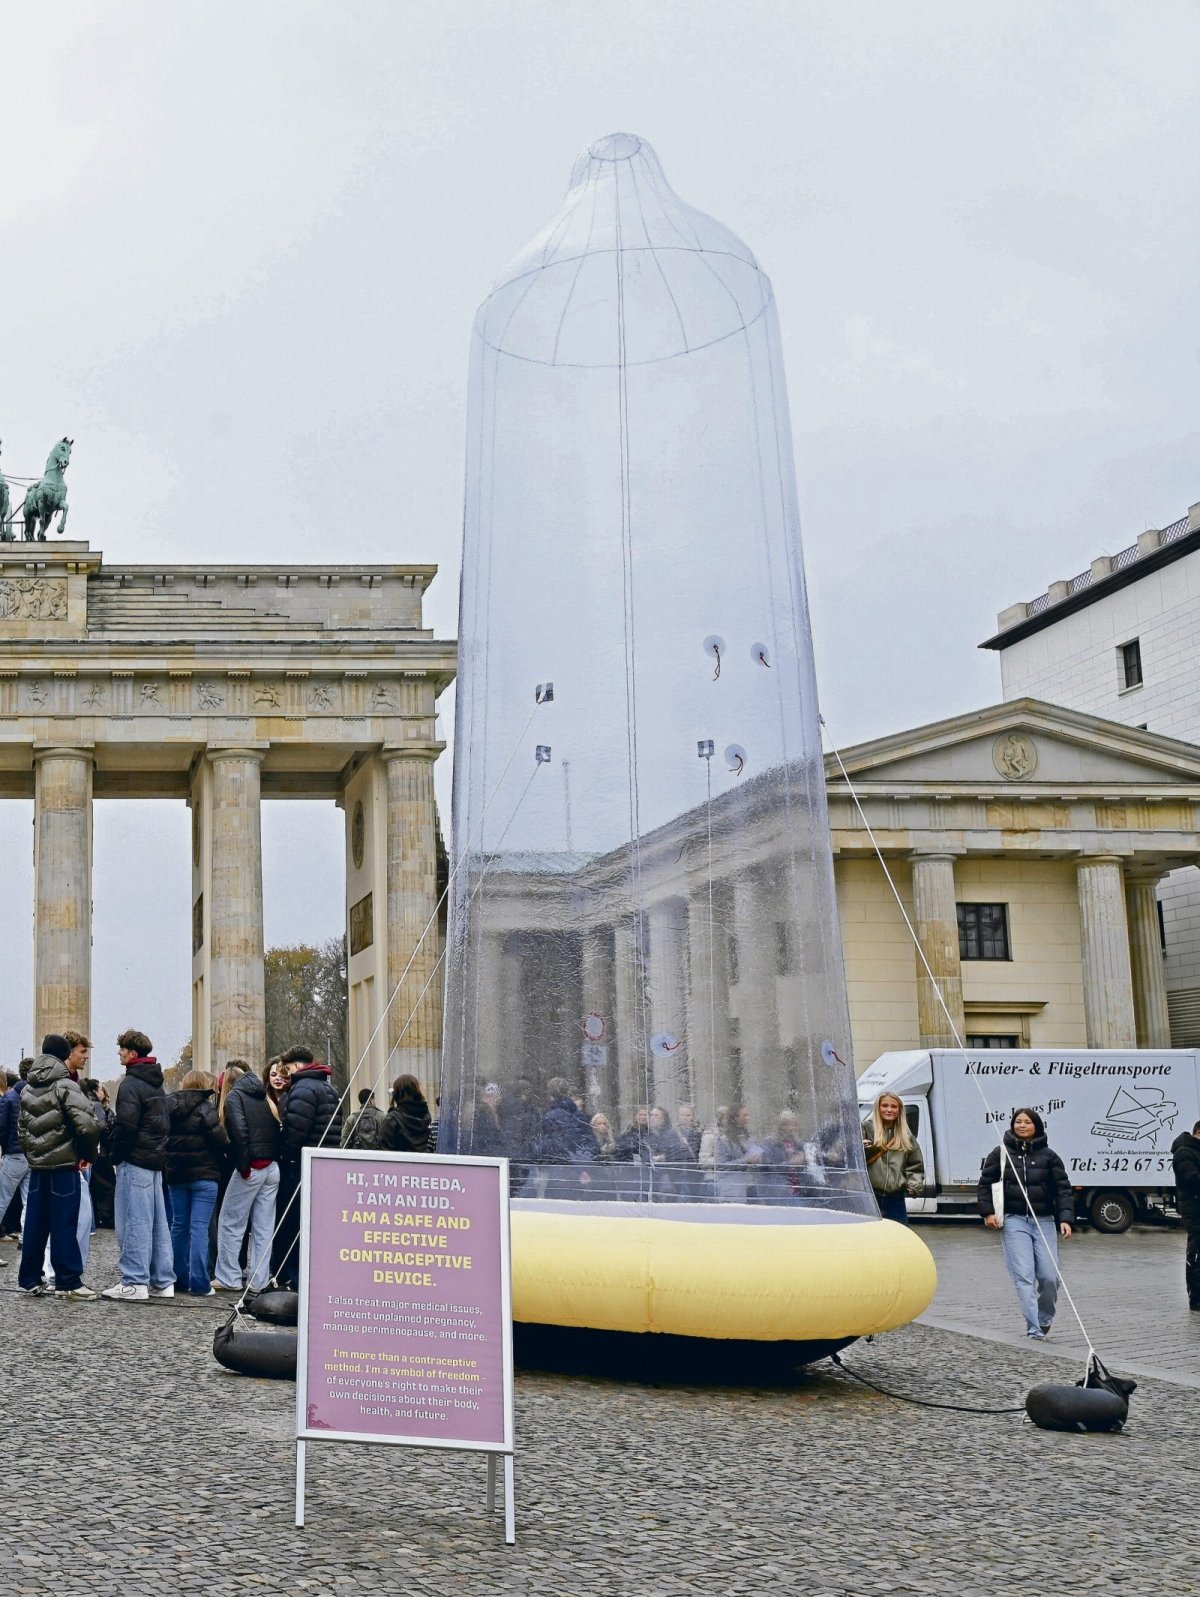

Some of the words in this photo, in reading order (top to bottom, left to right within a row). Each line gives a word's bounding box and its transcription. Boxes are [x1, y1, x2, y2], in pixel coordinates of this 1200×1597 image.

[964, 1061, 1024, 1075] Klavier-
[1029, 1061, 1041, 1075] &
[1047, 1061, 1172, 1079] Flügeltransporte
[985, 1110, 1005, 1124] Die
[1046, 1099, 1066, 1114] für
[1071, 1158, 1096, 1172] Tel:
[1102, 1158, 1128, 1172] 342
[1135, 1158, 1151, 1172] 67
[346, 1172, 368, 1187] HI,
[402, 1175, 466, 1193] FREEDA,
[357, 1192, 363, 1204] I
[367, 1193, 391, 1206] AM
[395, 1194, 416, 1208] AN
[421, 1196, 455, 1210] IUD.
[342, 1210, 349, 1222] I
[352, 1211, 376, 1224] AM
[380, 1212, 391, 1224] A
[394, 1213, 433, 1228] SAFE
[436, 1216, 470, 1230] AND
[364, 1231, 448, 1248] EFFECTIVE
[340, 1248, 472, 1269] CONTRACEPTIVE
[373, 1270, 437, 1287] DEVICE.
[328, 1296, 332, 1304] I
[334, 1296, 353, 1305] also
[356, 1297, 379, 1307] treat
[382, 1300, 410, 1310] major
[411, 1302, 448, 1312] medical
[450, 1303, 482, 1315] issues,
[333, 1310, 371, 1319] prevent
[373, 1313, 422, 1323] unplanned
[424, 1316, 477, 1328] pregnancy,
[323, 1323, 360, 1333] manage
[361, 1325, 437, 1339] perimenopause,
[439, 1330, 457, 1339] and
[459, 1332, 488, 1342] more.
[333, 1349, 348, 1358] I'm
[350, 1351, 376, 1360] more
[378, 1352, 400, 1362] than
[409, 1356, 477, 1368] contraceptive
[324, 1362, 363, 1373] method.
[365, 1364, 380, 1374] I'm
[382, 1367, 388, 1375] a
[390, 1368, 424, 1377] symbol
[426, 1370, 436, 1378] of
[438, 1370, 480, 1382] freedom
[326, 1375, 337, 1385] of
[338, 1377, 390, 1389] everyone's
[392, 1380, 417, 1391] right
[419, 1383, 429, 1391] to
[431, 1384, 457, 1394] make
[459, 1386, 484, 1396] their
[329, 1390, 350, 1399] own
[352, 1391, 397, 1403] decisions
[398, 1394, 426, 1405] about
[428, 1396, 452, 1407] their
[454, 1398, 480, 1411] body,
[360, 1404, 393, 1417] health,
[395, 1407, 413, 1418] and
[415, 1409, 449, 1421] future.
